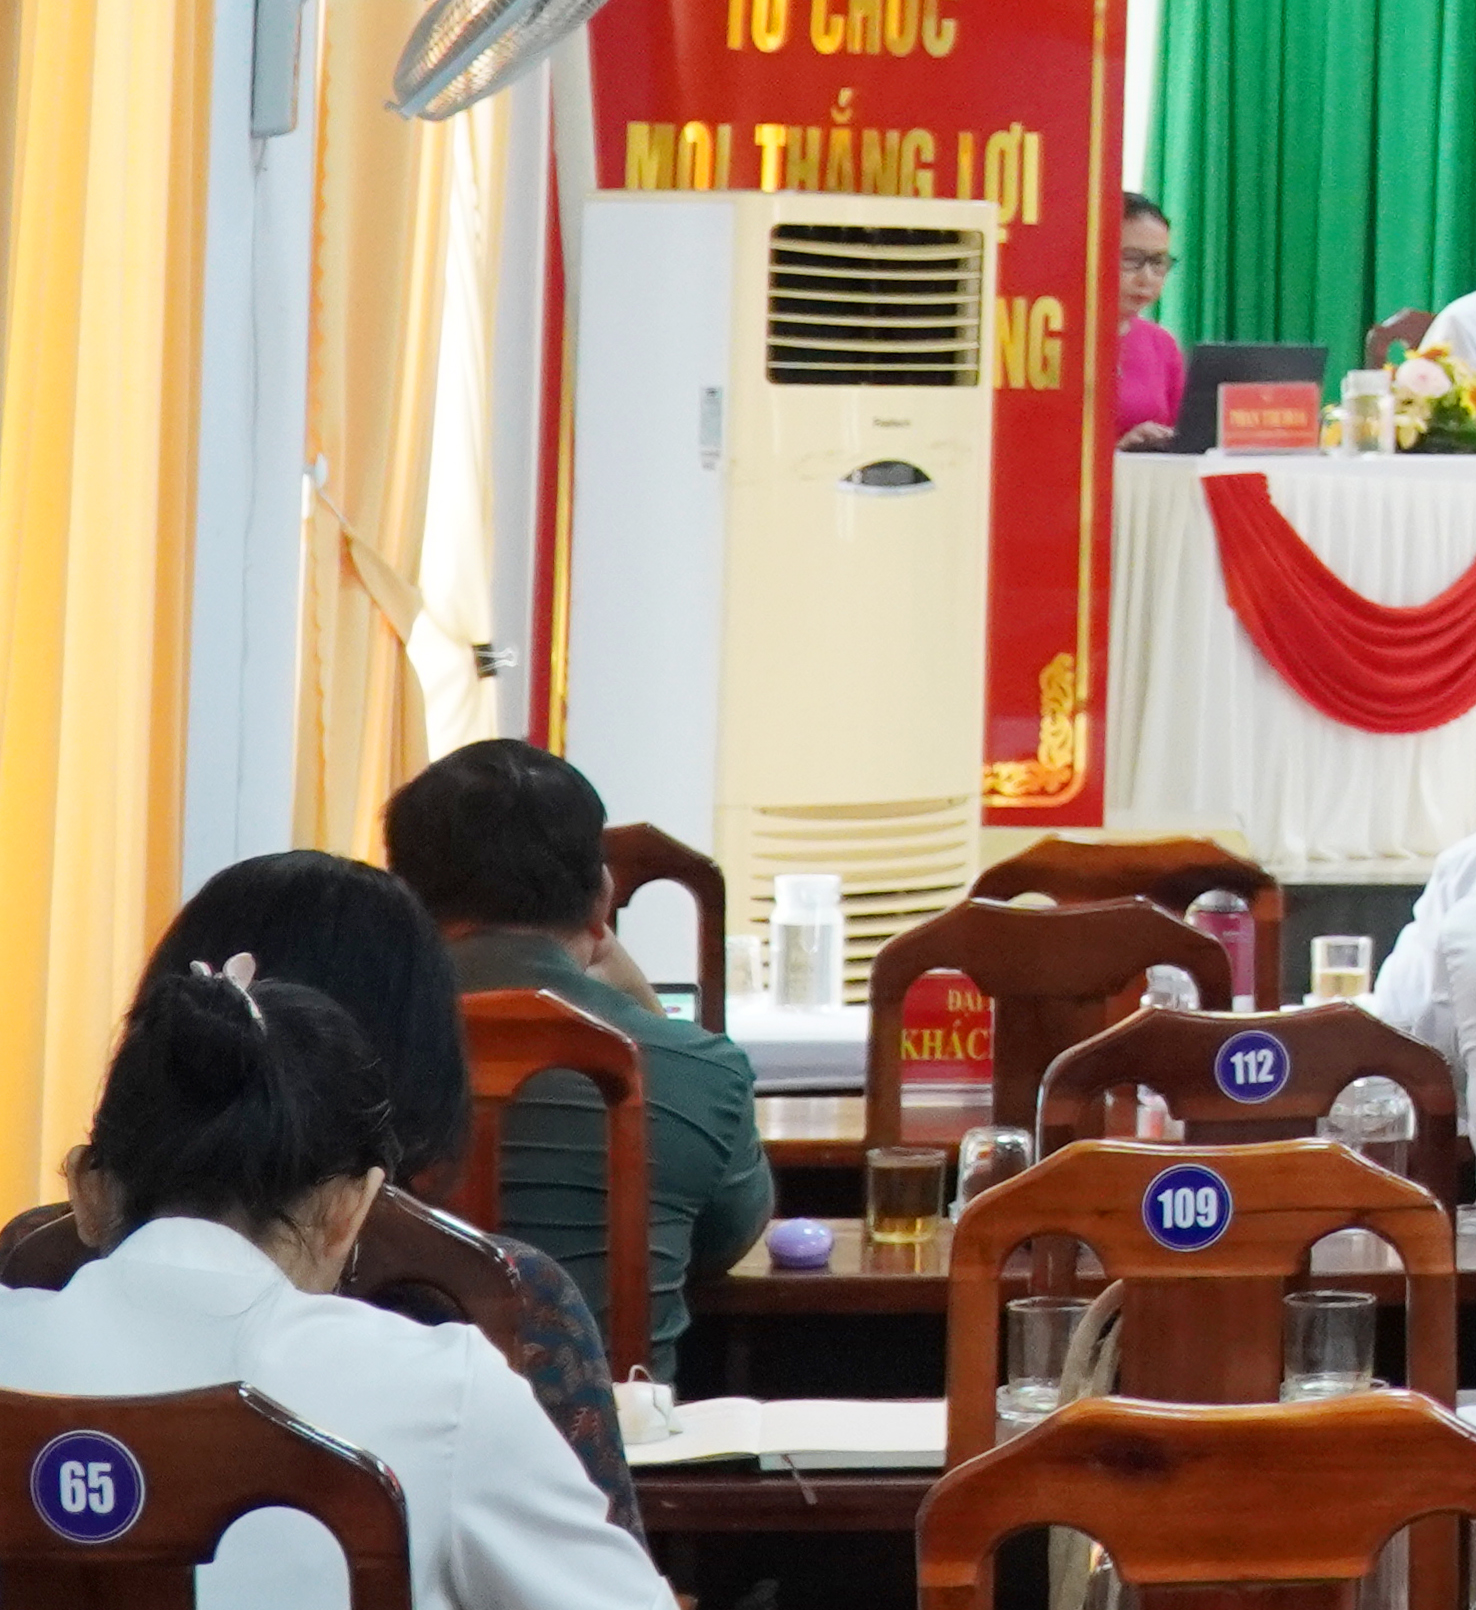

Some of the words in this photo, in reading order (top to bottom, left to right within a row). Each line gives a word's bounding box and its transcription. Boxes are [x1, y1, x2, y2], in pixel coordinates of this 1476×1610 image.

[1229, 1049, 1274, 1085] 112
[1157, 1187, 1216, 1229] 109
[58, 1460, 115, 1515] 65
